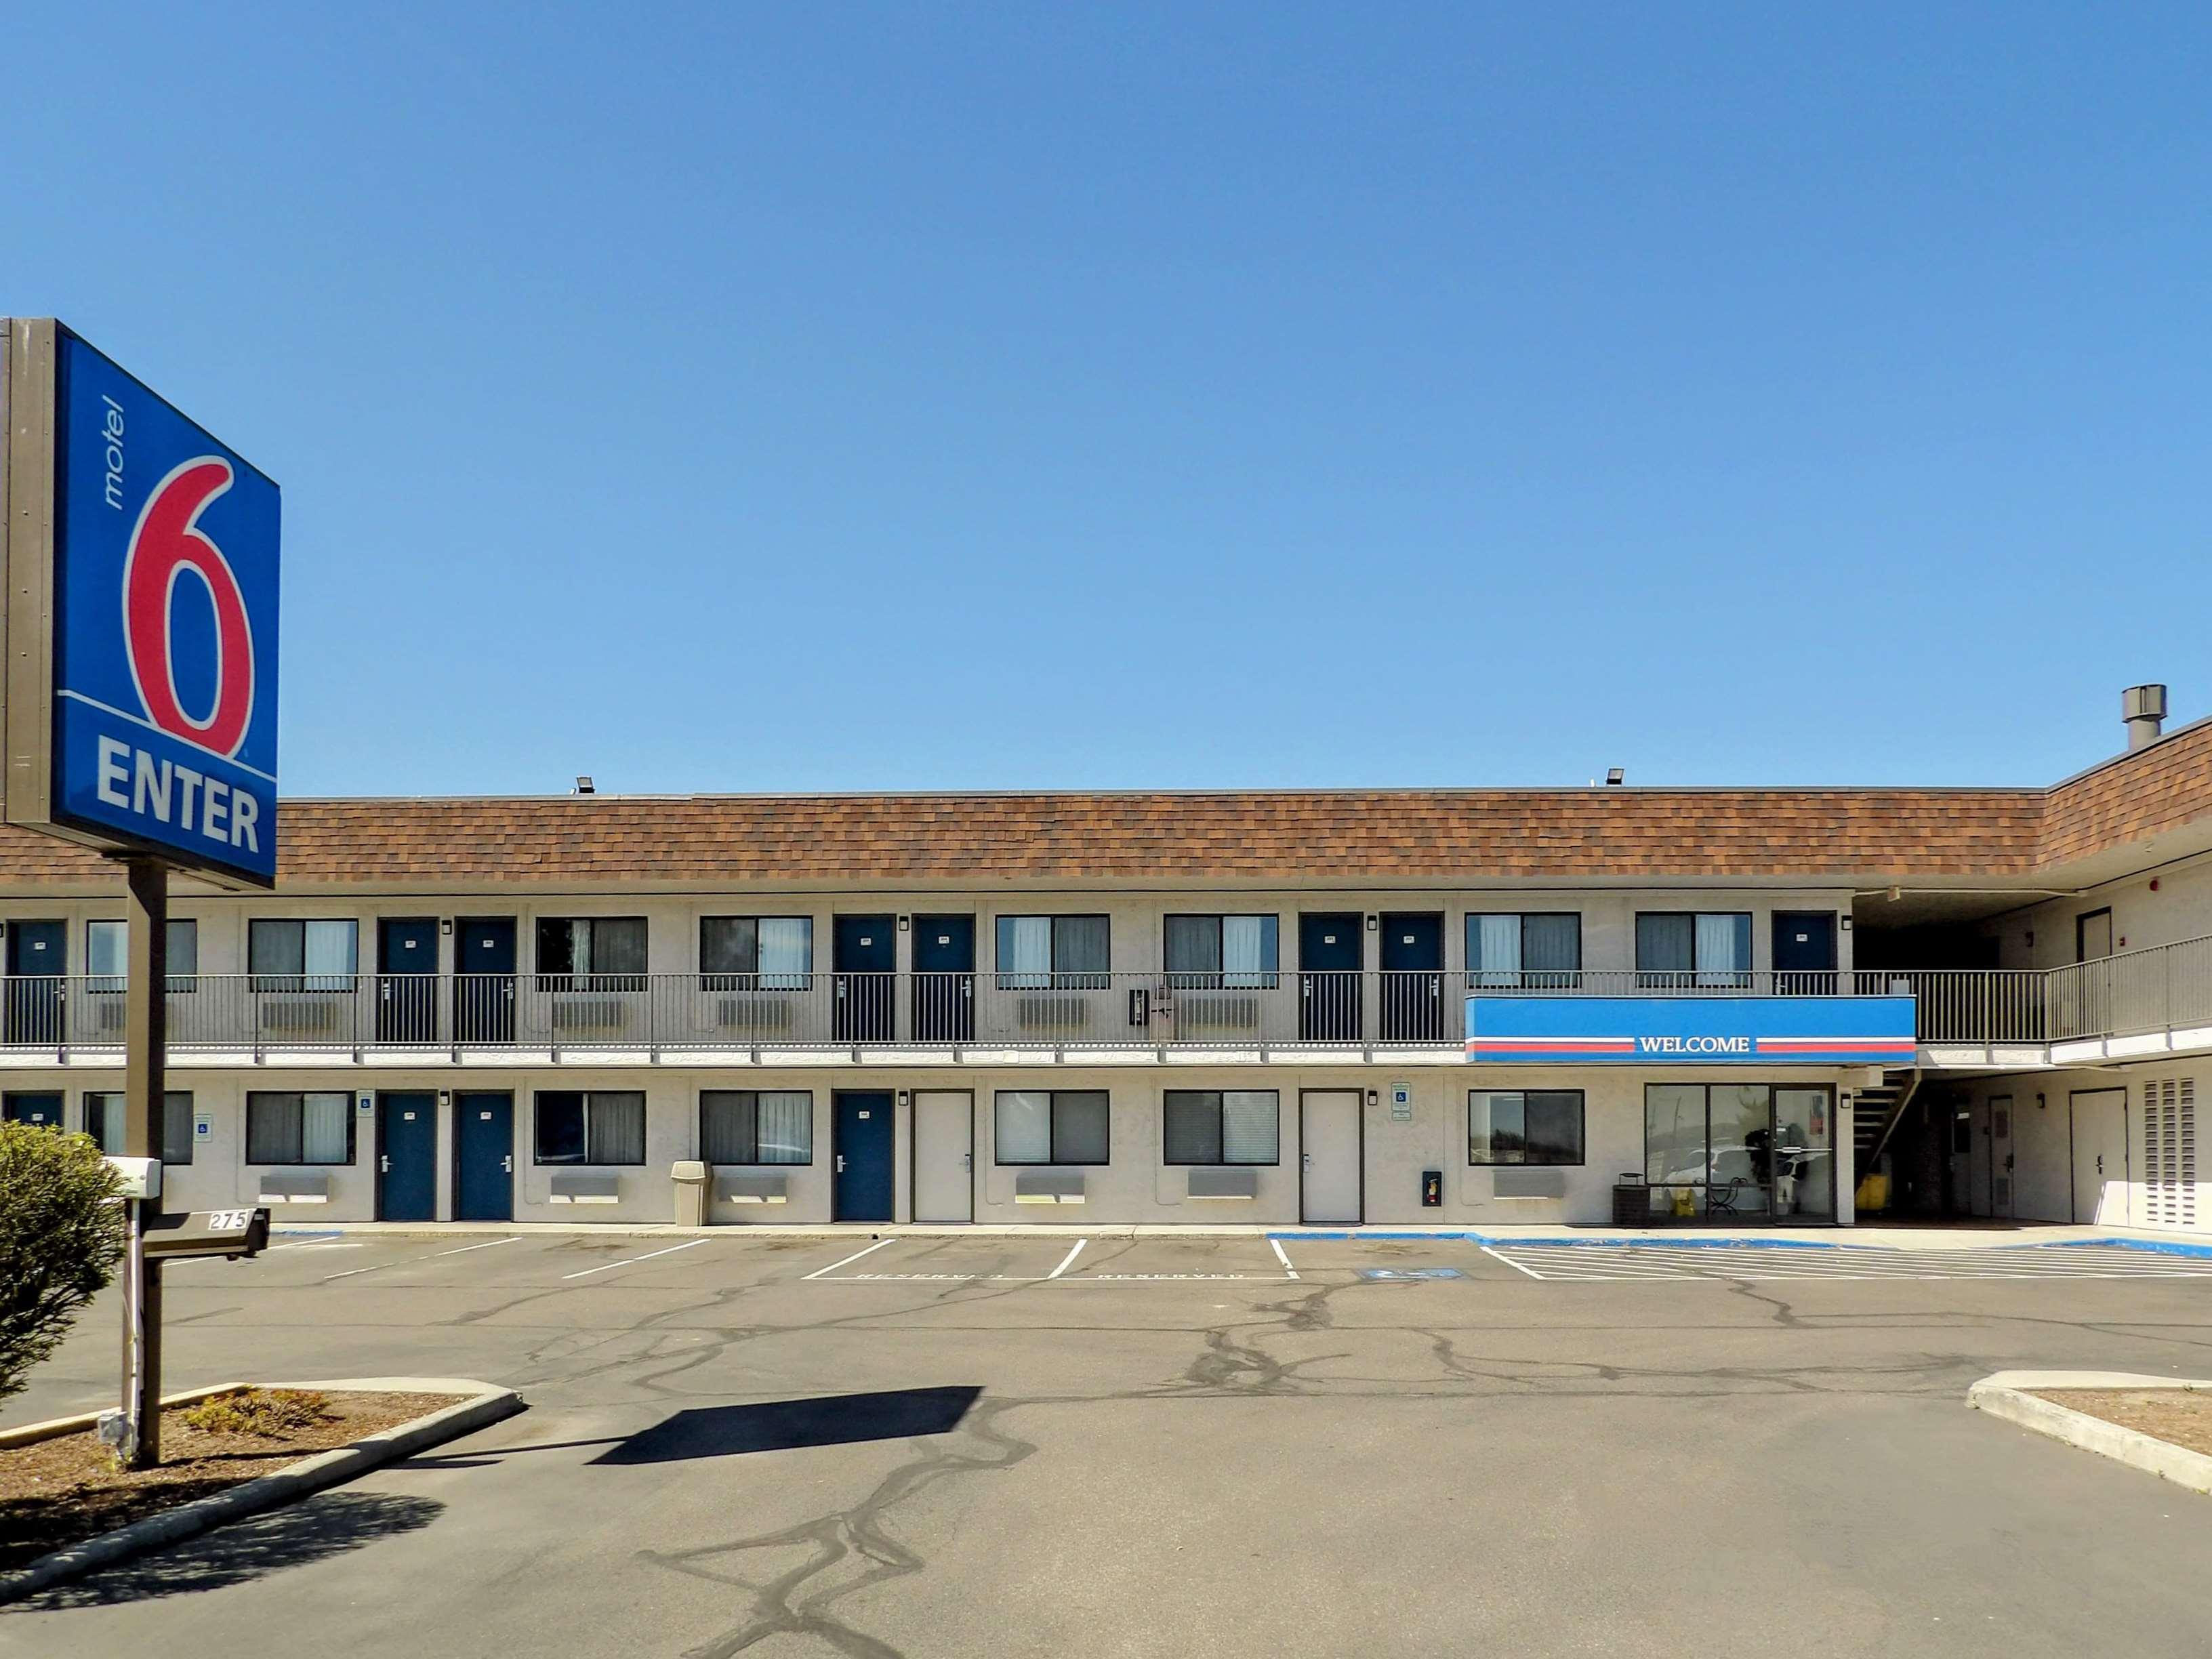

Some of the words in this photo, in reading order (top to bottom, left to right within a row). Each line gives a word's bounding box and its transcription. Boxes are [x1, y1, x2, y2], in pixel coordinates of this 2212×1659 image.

[102, 394, 124, 510] motel
[123, 455, 255, 761] 6
[98, 735, 259, 853] ENTER
[1639, 1037, 1750, 1052] WELCOME
[210, 1212, 245, 1229] 275
